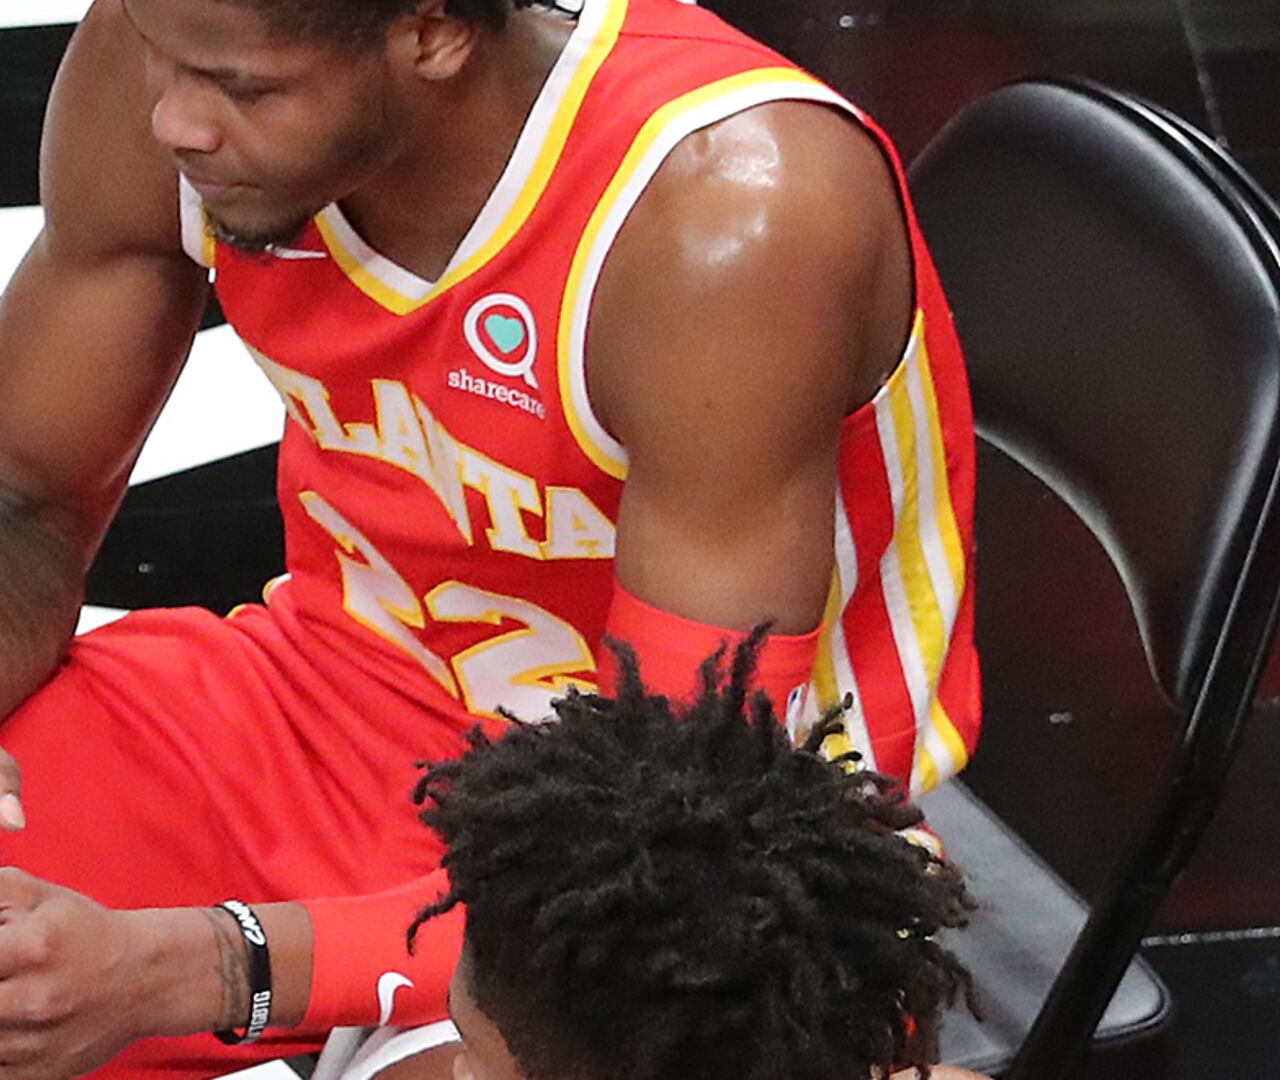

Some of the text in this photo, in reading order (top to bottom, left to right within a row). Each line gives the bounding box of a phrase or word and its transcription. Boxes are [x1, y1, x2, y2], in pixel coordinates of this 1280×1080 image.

[246, 343, 617, 561] TLANTA
[447, 368, 546, 420] sharecare
[298, 490, 600, 723] 22
